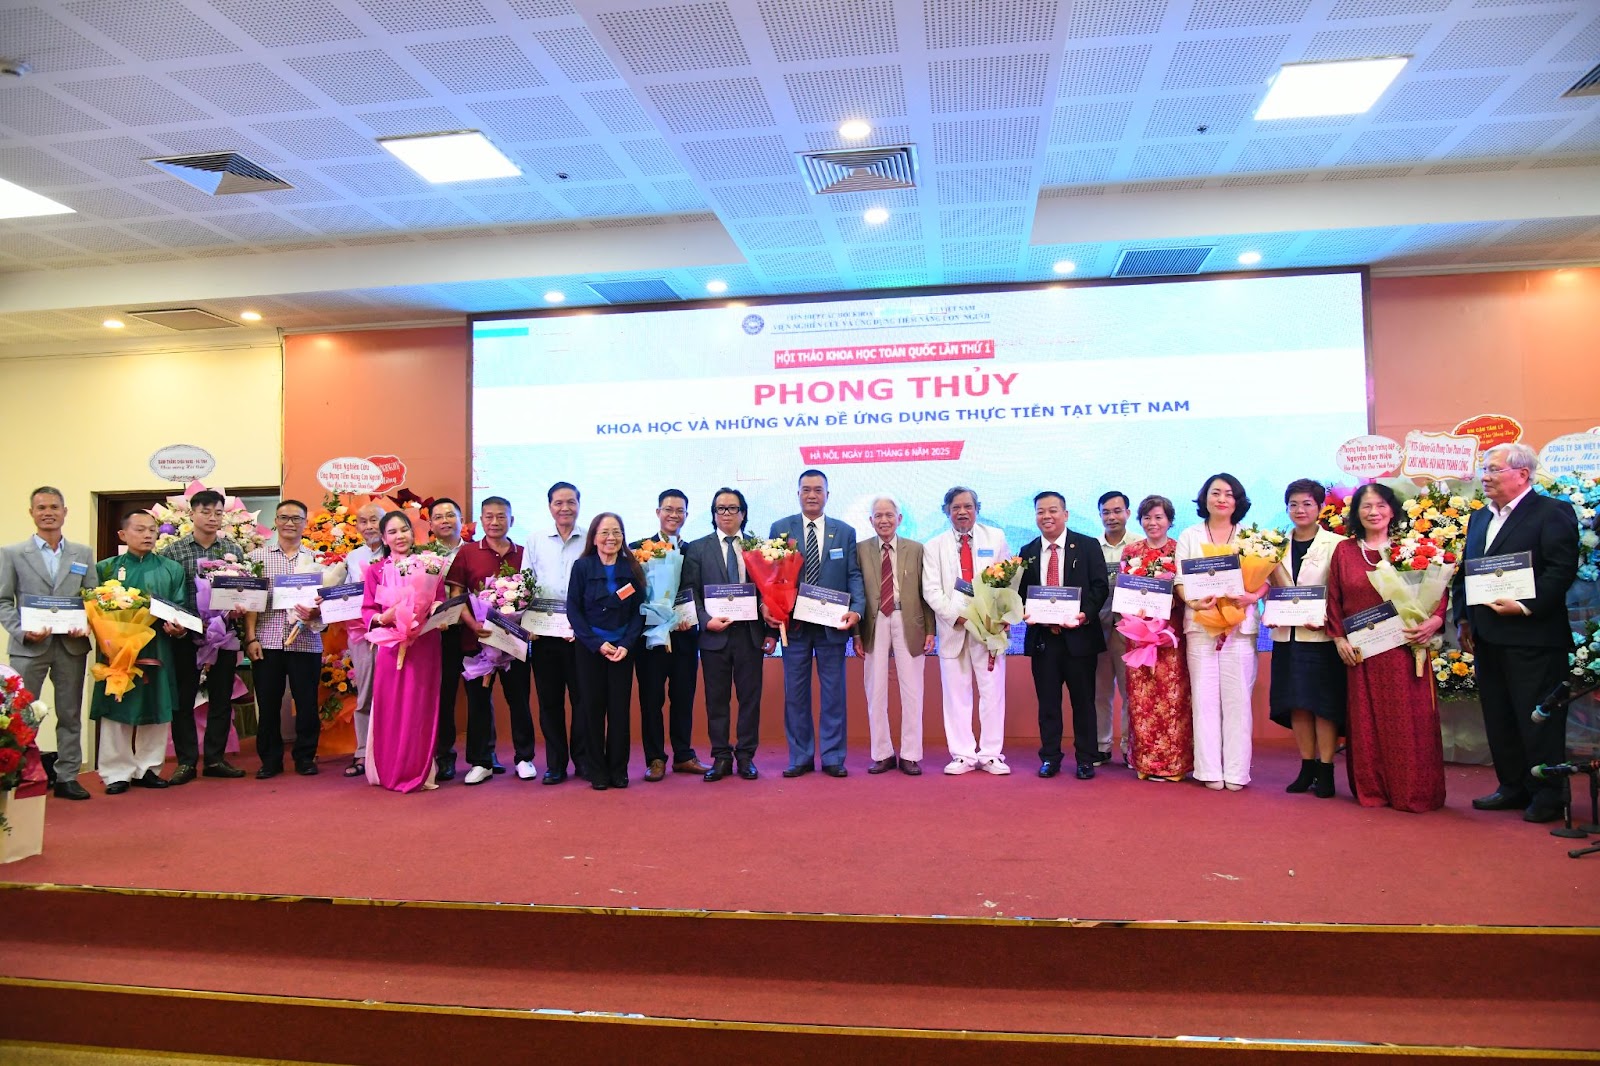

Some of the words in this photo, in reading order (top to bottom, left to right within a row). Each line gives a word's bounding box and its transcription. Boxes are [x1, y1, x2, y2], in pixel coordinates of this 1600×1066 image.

[776, 350, 796, 365] HỘI
[798, 348, 823, 362] THẢO
[826, 348, 854, 362] KHOA
[856, 348, 877, 362] HỌC
[879, 344, 906, 359] TOÀN
[908, 342, 936, 358] QUỐC
[939, 342, 958, 356] LẦN
[961, 340, 983, 354] THỨ
[984, 344, 991, 354] 1
[754, 378, 894, 406] PHONG
[907, 366, 1019, 398] THỦY
[596, 422, 642, 434] KHOA
[648, 420, 683, 436] HỌC
[688, 418, 710, 432] VÀ
[716, 415, 778, 431] NHỮNG
[784, 412, 819, 428] VẤN
[825, 411, 848, 426] ĐỀ
[854, 410, 893, 424] ỨNG
[899, 410, 950, 424] DỤNG
[956, 407, 1006, 422] THỰC
[1010, 402, 1054, 418] TIỄN
[1060, 404, 1092, 419] TẠI
[1098, 400, 1142, 416] VIỆT
[1148, 400, 1190, 413] NAM
[810, 451, 821, 460] HÀ
[842, 450, 862, 459] NGÀY
[876, 448, 902, 458] THÁNG
[912, 446, 929, 456] NĂM
[931, 447, 950, 456] 2025
[1548, 444, 1564, 452] CÔNG
[1566, 444, 1572, 452] TY
[1368, 454, 1378, 462] Huy
[344, 462, 360, 472] Nghiên
